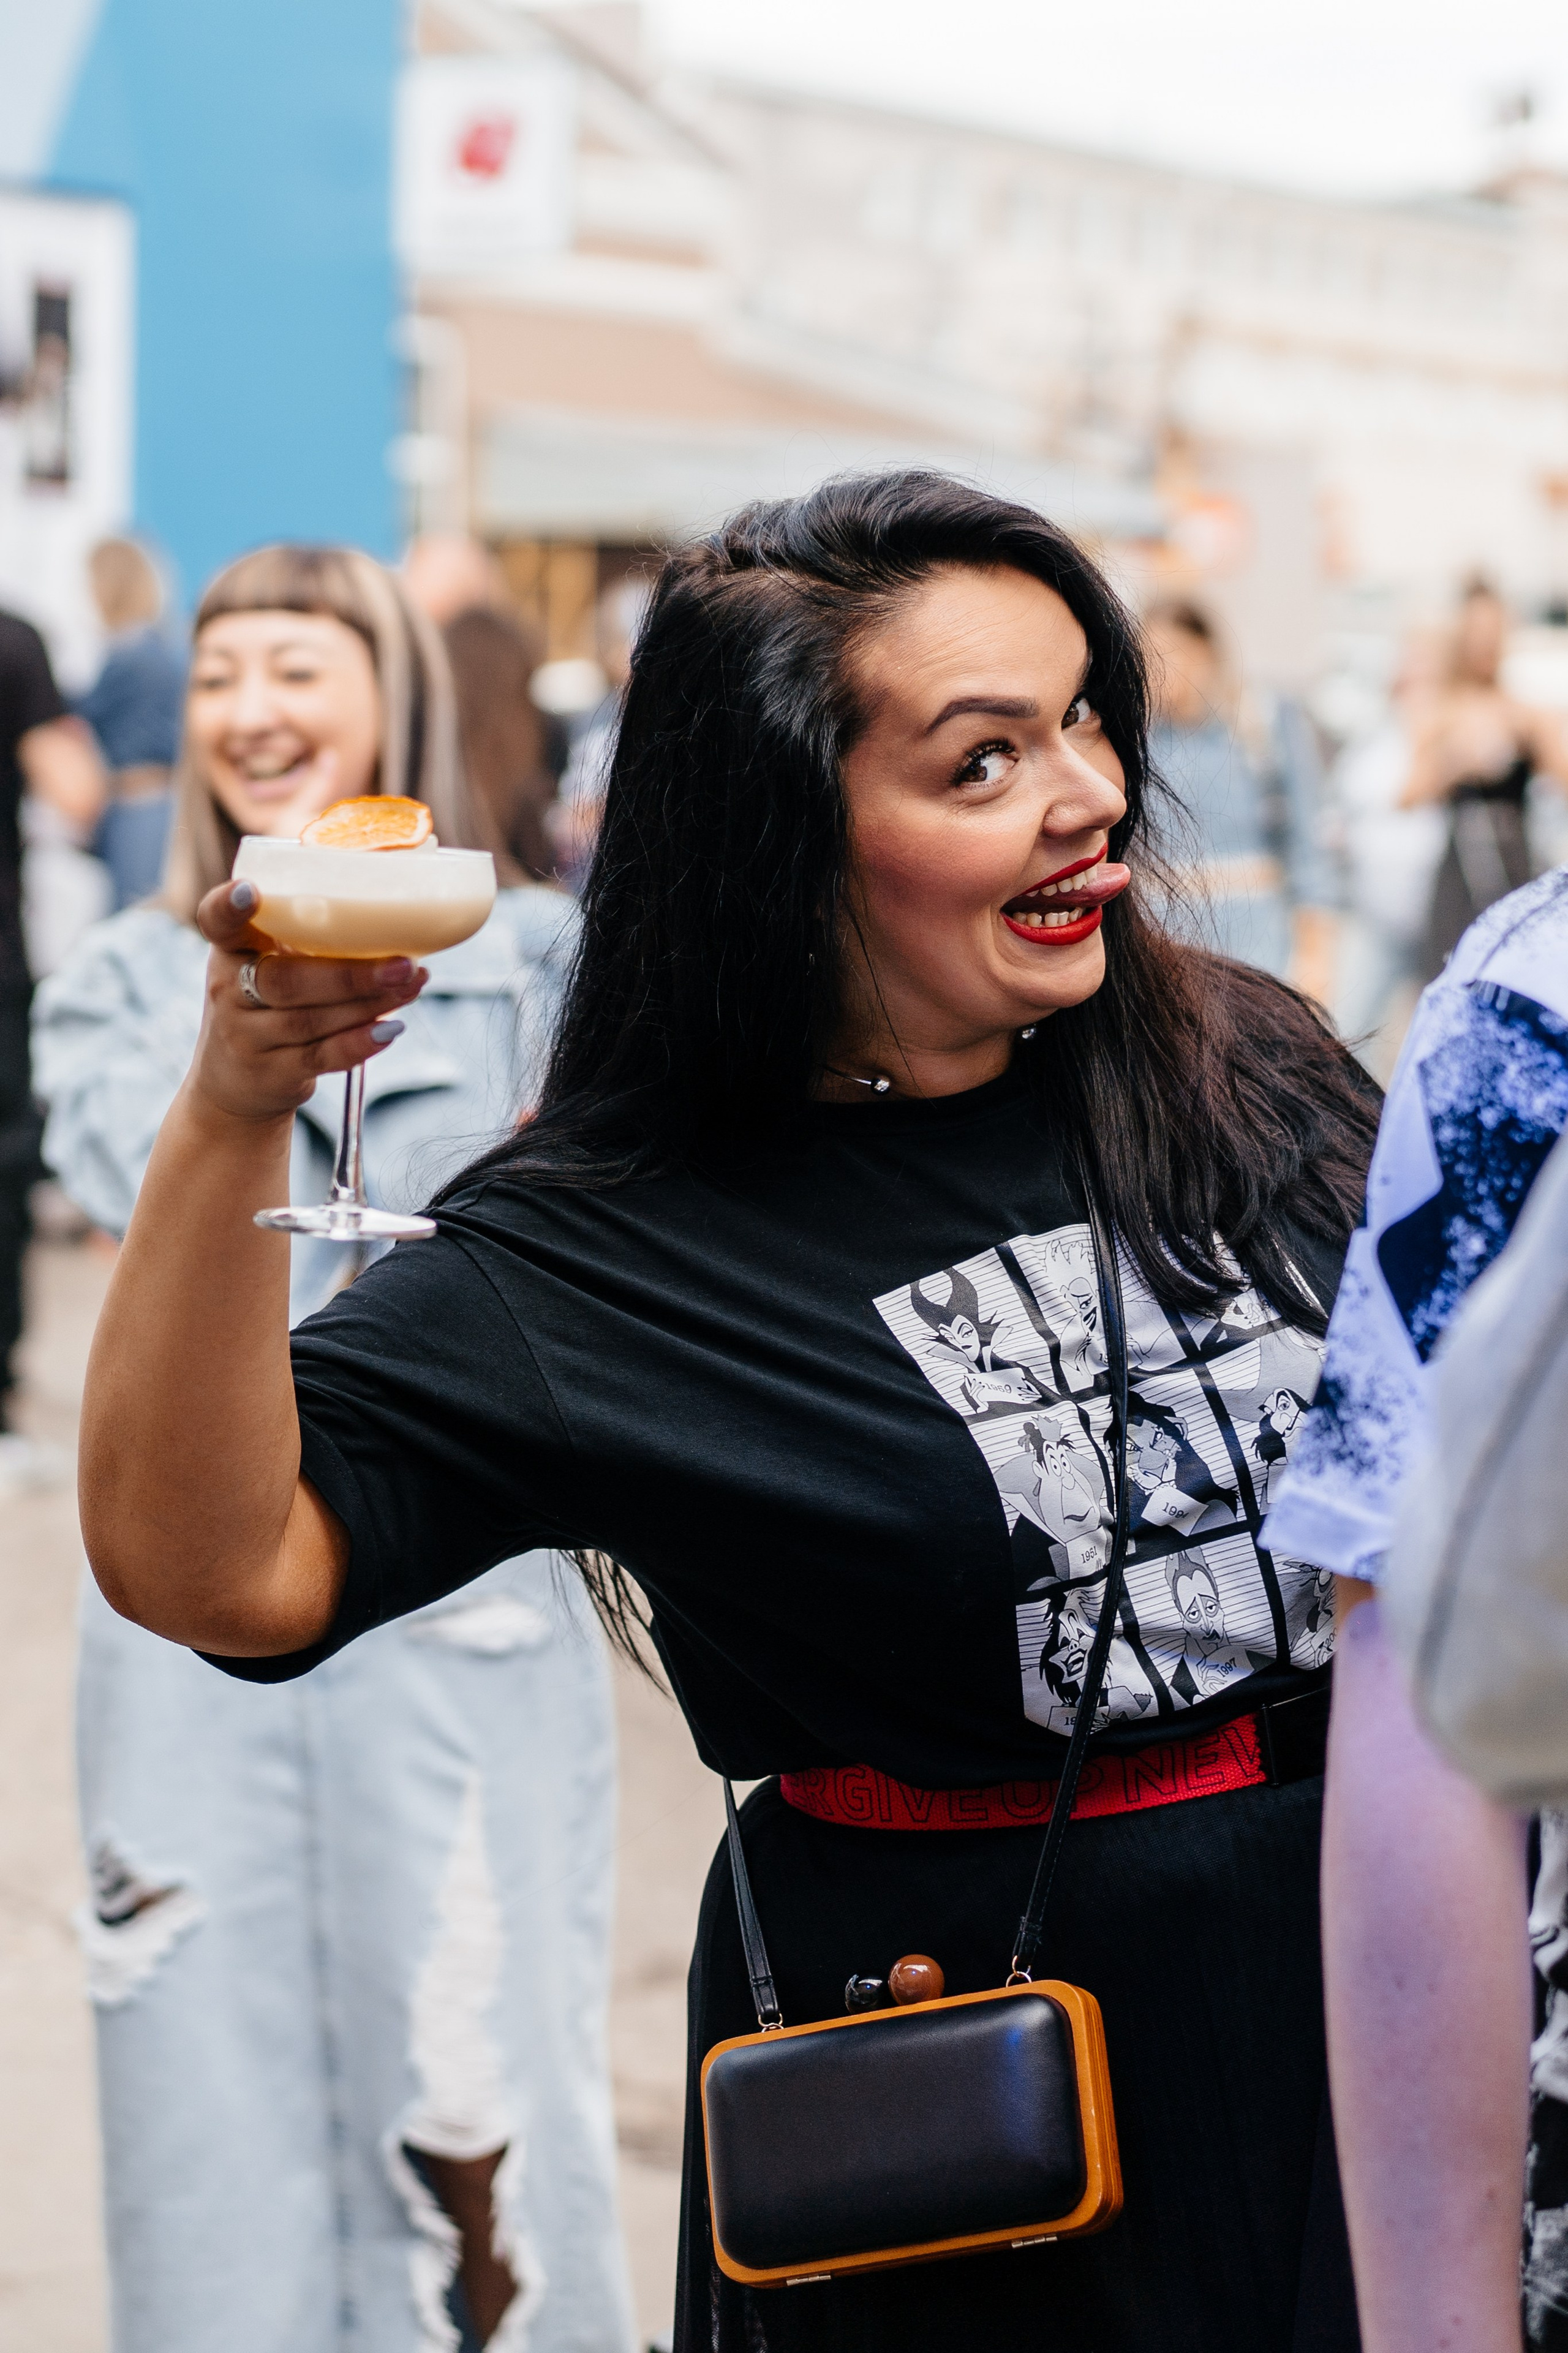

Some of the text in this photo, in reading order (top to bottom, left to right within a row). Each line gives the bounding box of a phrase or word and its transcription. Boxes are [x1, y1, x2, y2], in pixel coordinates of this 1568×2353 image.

[1325, 1627, 1338, 1647] 200
[1216, 1656, 1237, 1677] 1997
[1064, 1716, 1077, 1726] 19
[834, 1765, 989, 1822] GIVE
[1122, 1726, 1261, 1804] NEV
